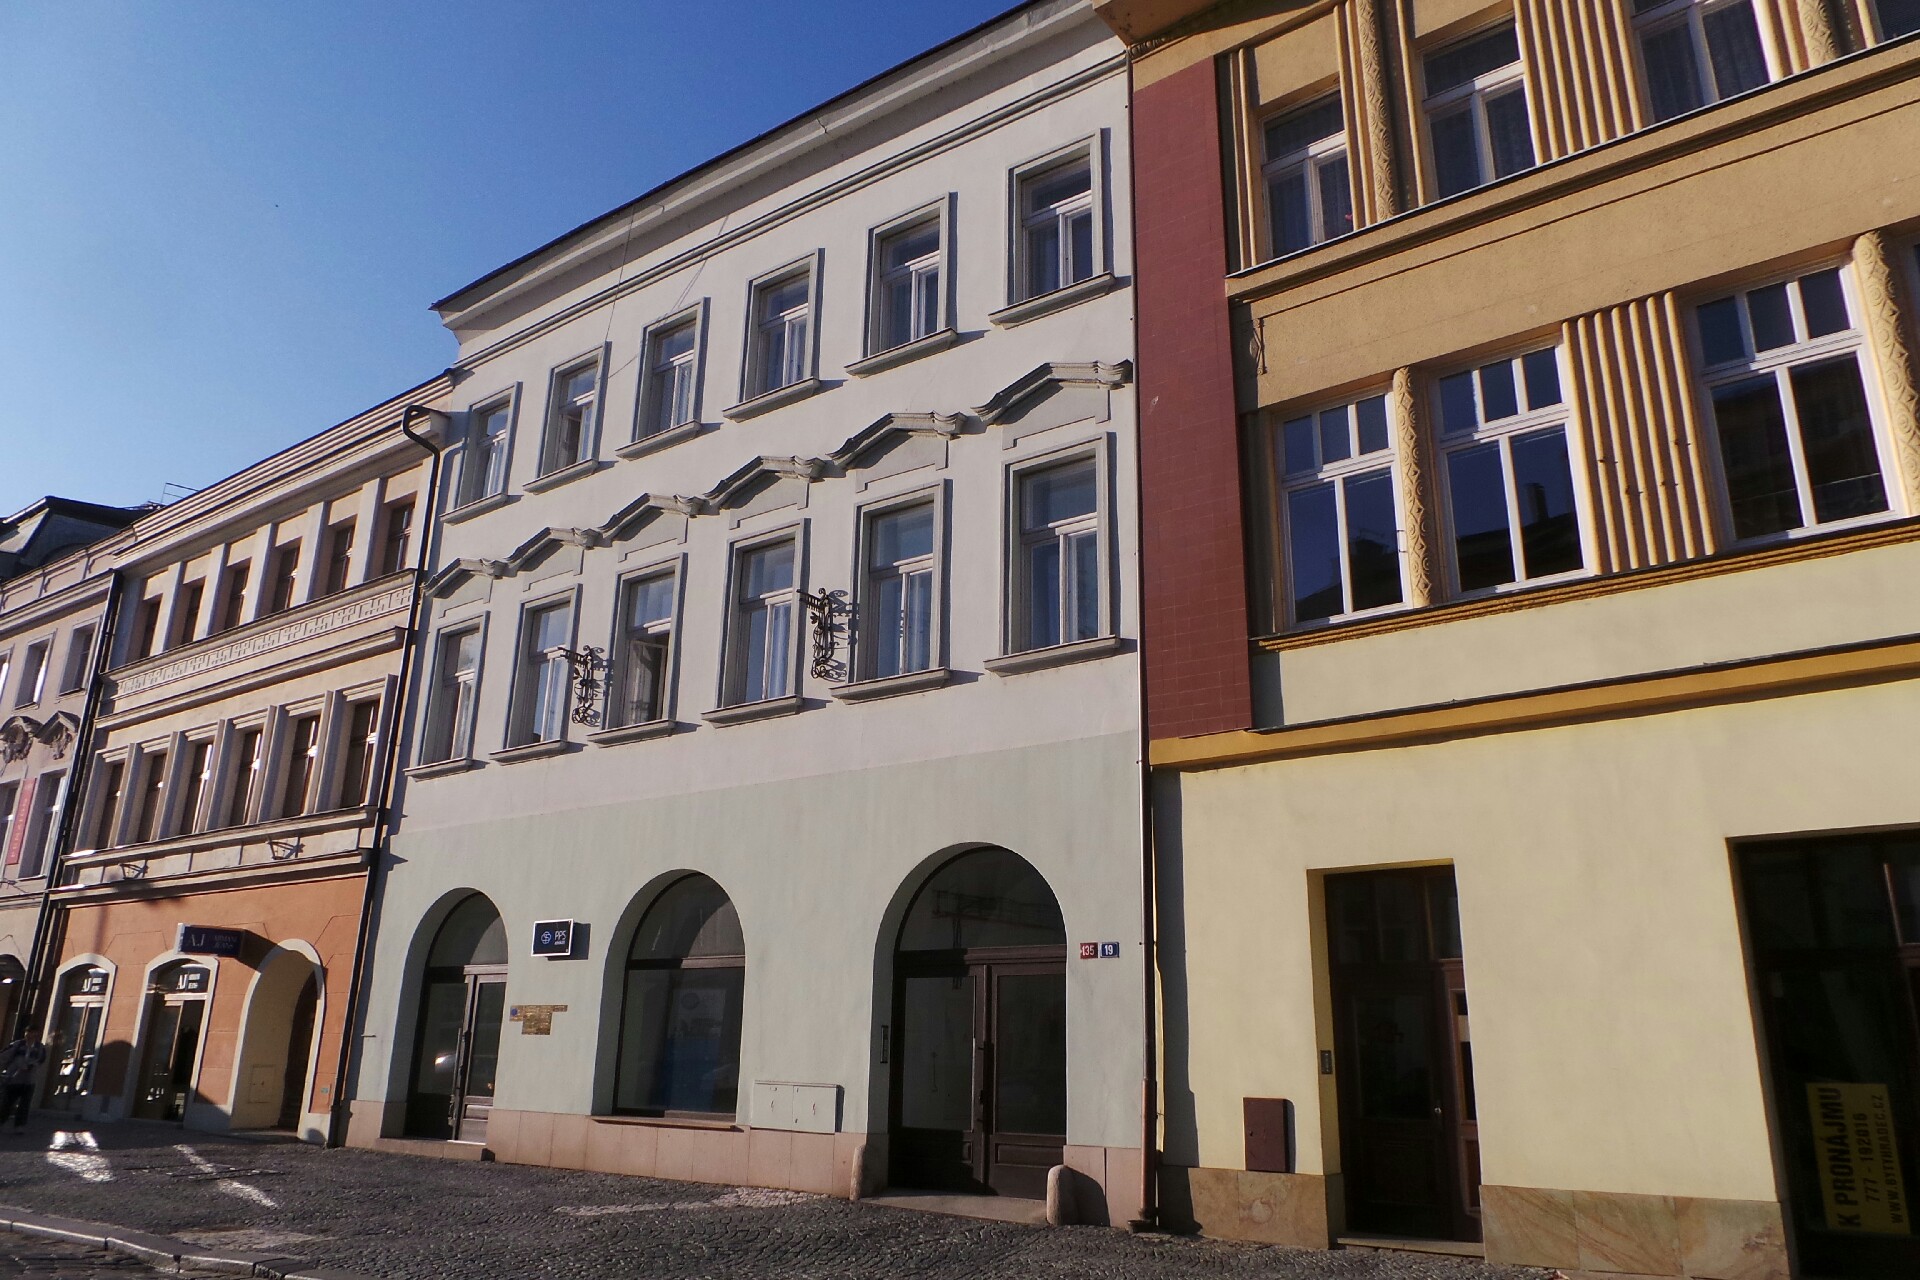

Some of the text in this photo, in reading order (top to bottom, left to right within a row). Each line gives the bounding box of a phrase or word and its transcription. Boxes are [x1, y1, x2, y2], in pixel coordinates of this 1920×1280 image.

[1082, 945, 1095, 956] 135
[1104, 944, 1114, 955] 19
[1817, 1087, 1861, 1227] K PRONÁJMU
[1863, 1178, 1880, 1202] 777
